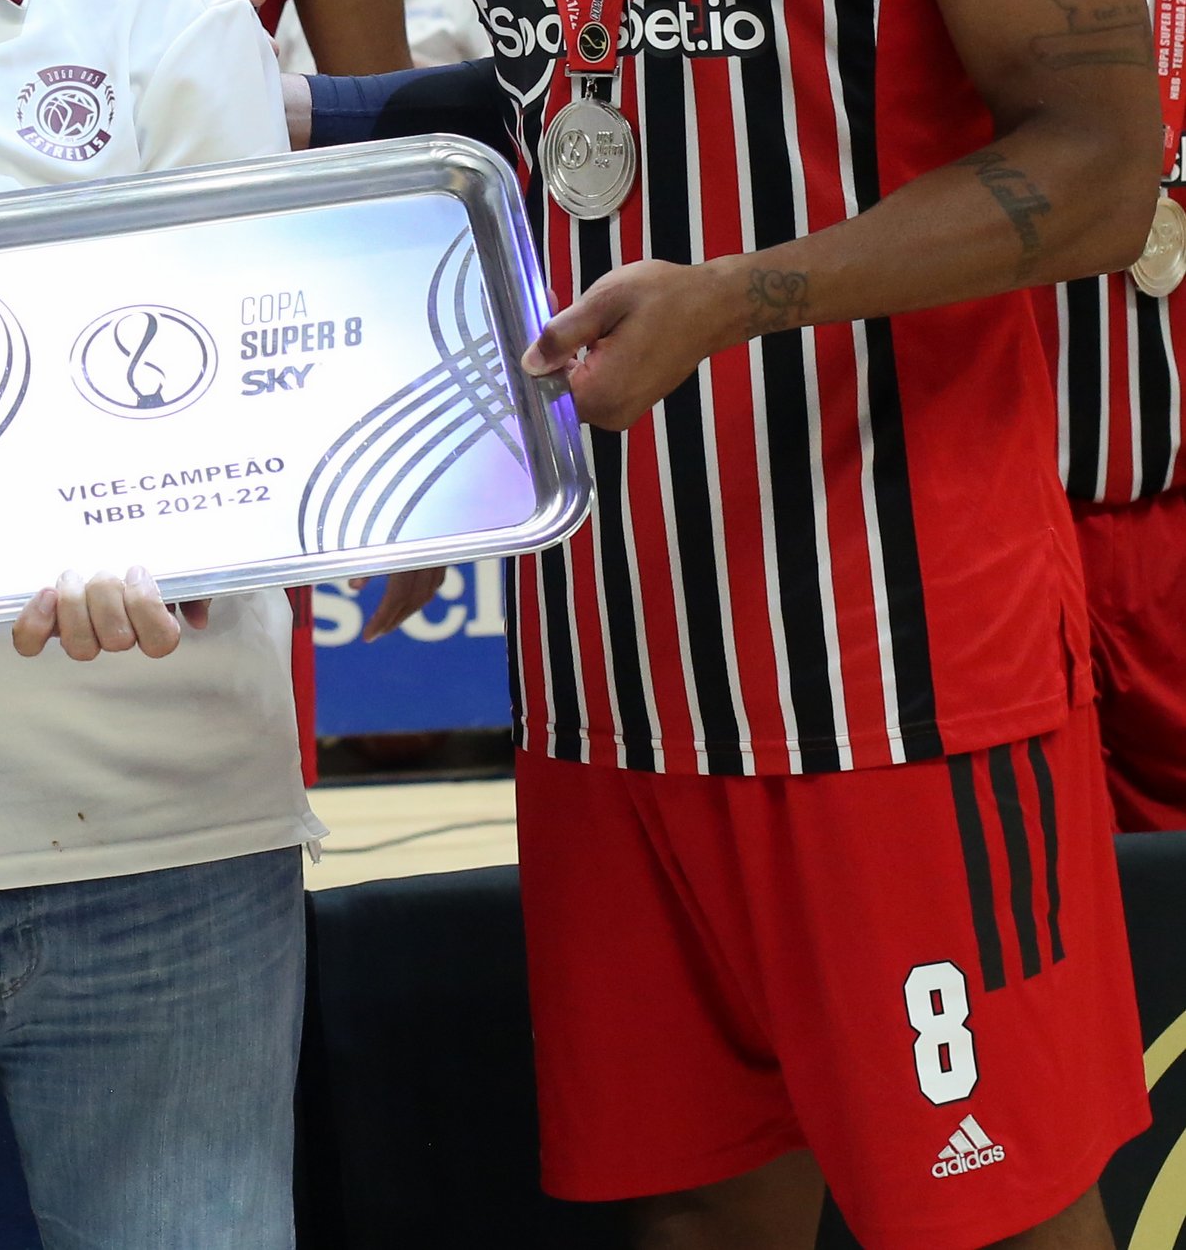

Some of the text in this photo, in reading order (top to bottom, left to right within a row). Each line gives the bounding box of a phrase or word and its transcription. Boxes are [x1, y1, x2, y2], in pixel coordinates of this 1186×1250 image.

[1160, 12, 1171, 46] SUPER
[1172, 6, 1186, 68] TEMPORADA
[47, 70, 73, 82] JOGO
[1158, 48, 1169, 76] COPA
[23, 132, 105, 161] ESTRELAS
[241, 290, 308, 326] COPA
[240, 316, 363, 361] SUPER 8
[240, 363, 316, 396] SKY
[57, 457, 285, 502] VICE-CAMPEÃO
[83, 485, 272, 526] NBB 2021-22
[904, 959, 979, 1106] 8
[931, 1144, 1006, 1179] adidas
